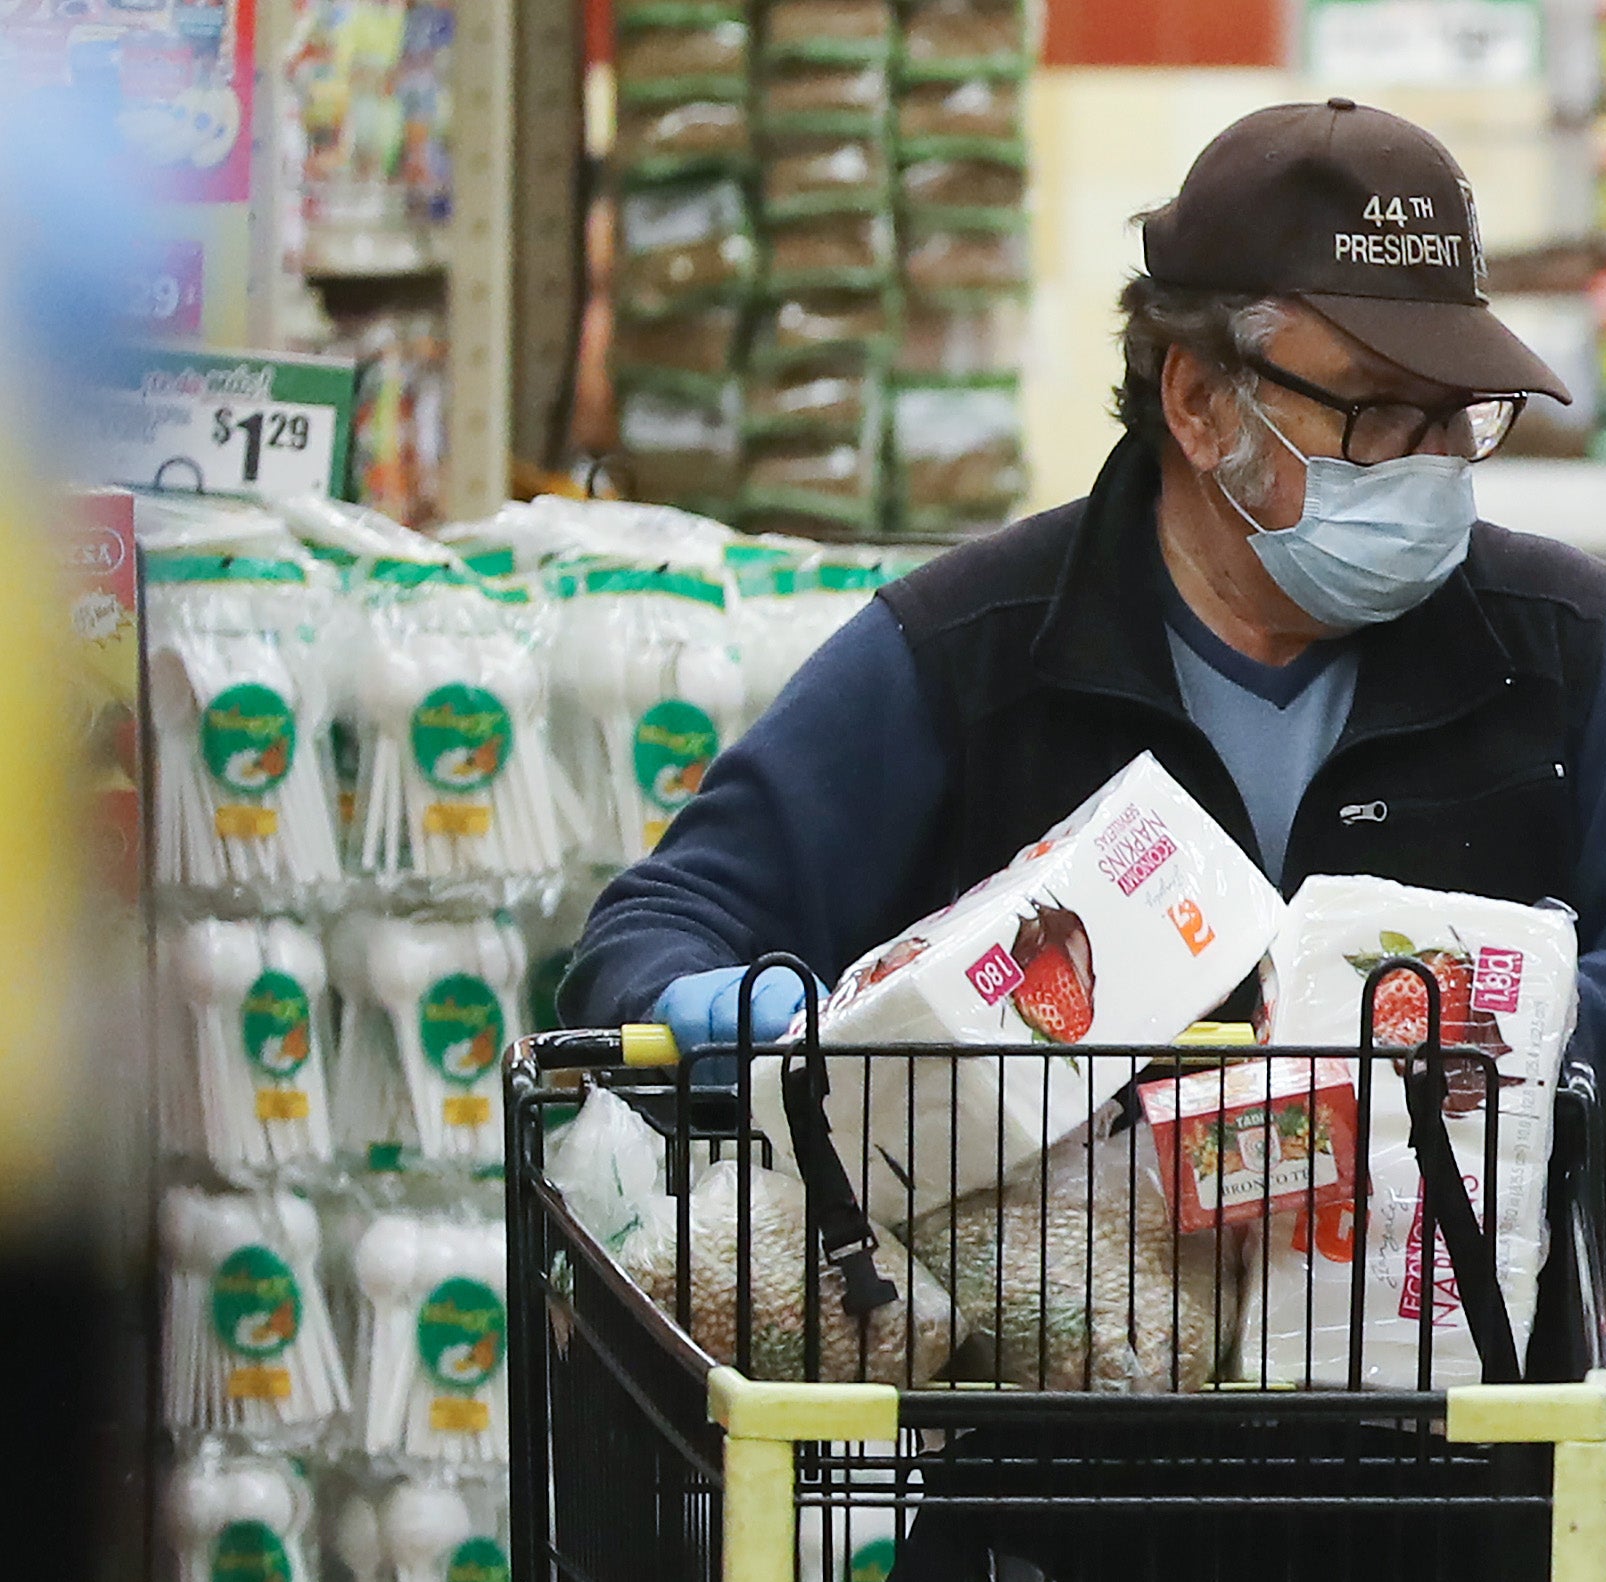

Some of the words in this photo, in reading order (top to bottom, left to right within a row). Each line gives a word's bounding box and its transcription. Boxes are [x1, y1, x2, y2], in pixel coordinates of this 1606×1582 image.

[1335, 233, 1462, 267] PRESIDENT
[1099, 809, 1167, 882] NAPKINS
[1120, 836, 1176, 893] ECONOMY
[975, 954, 1014, 995] 180
[1222, 1173, 1288, 1197] BRONO
